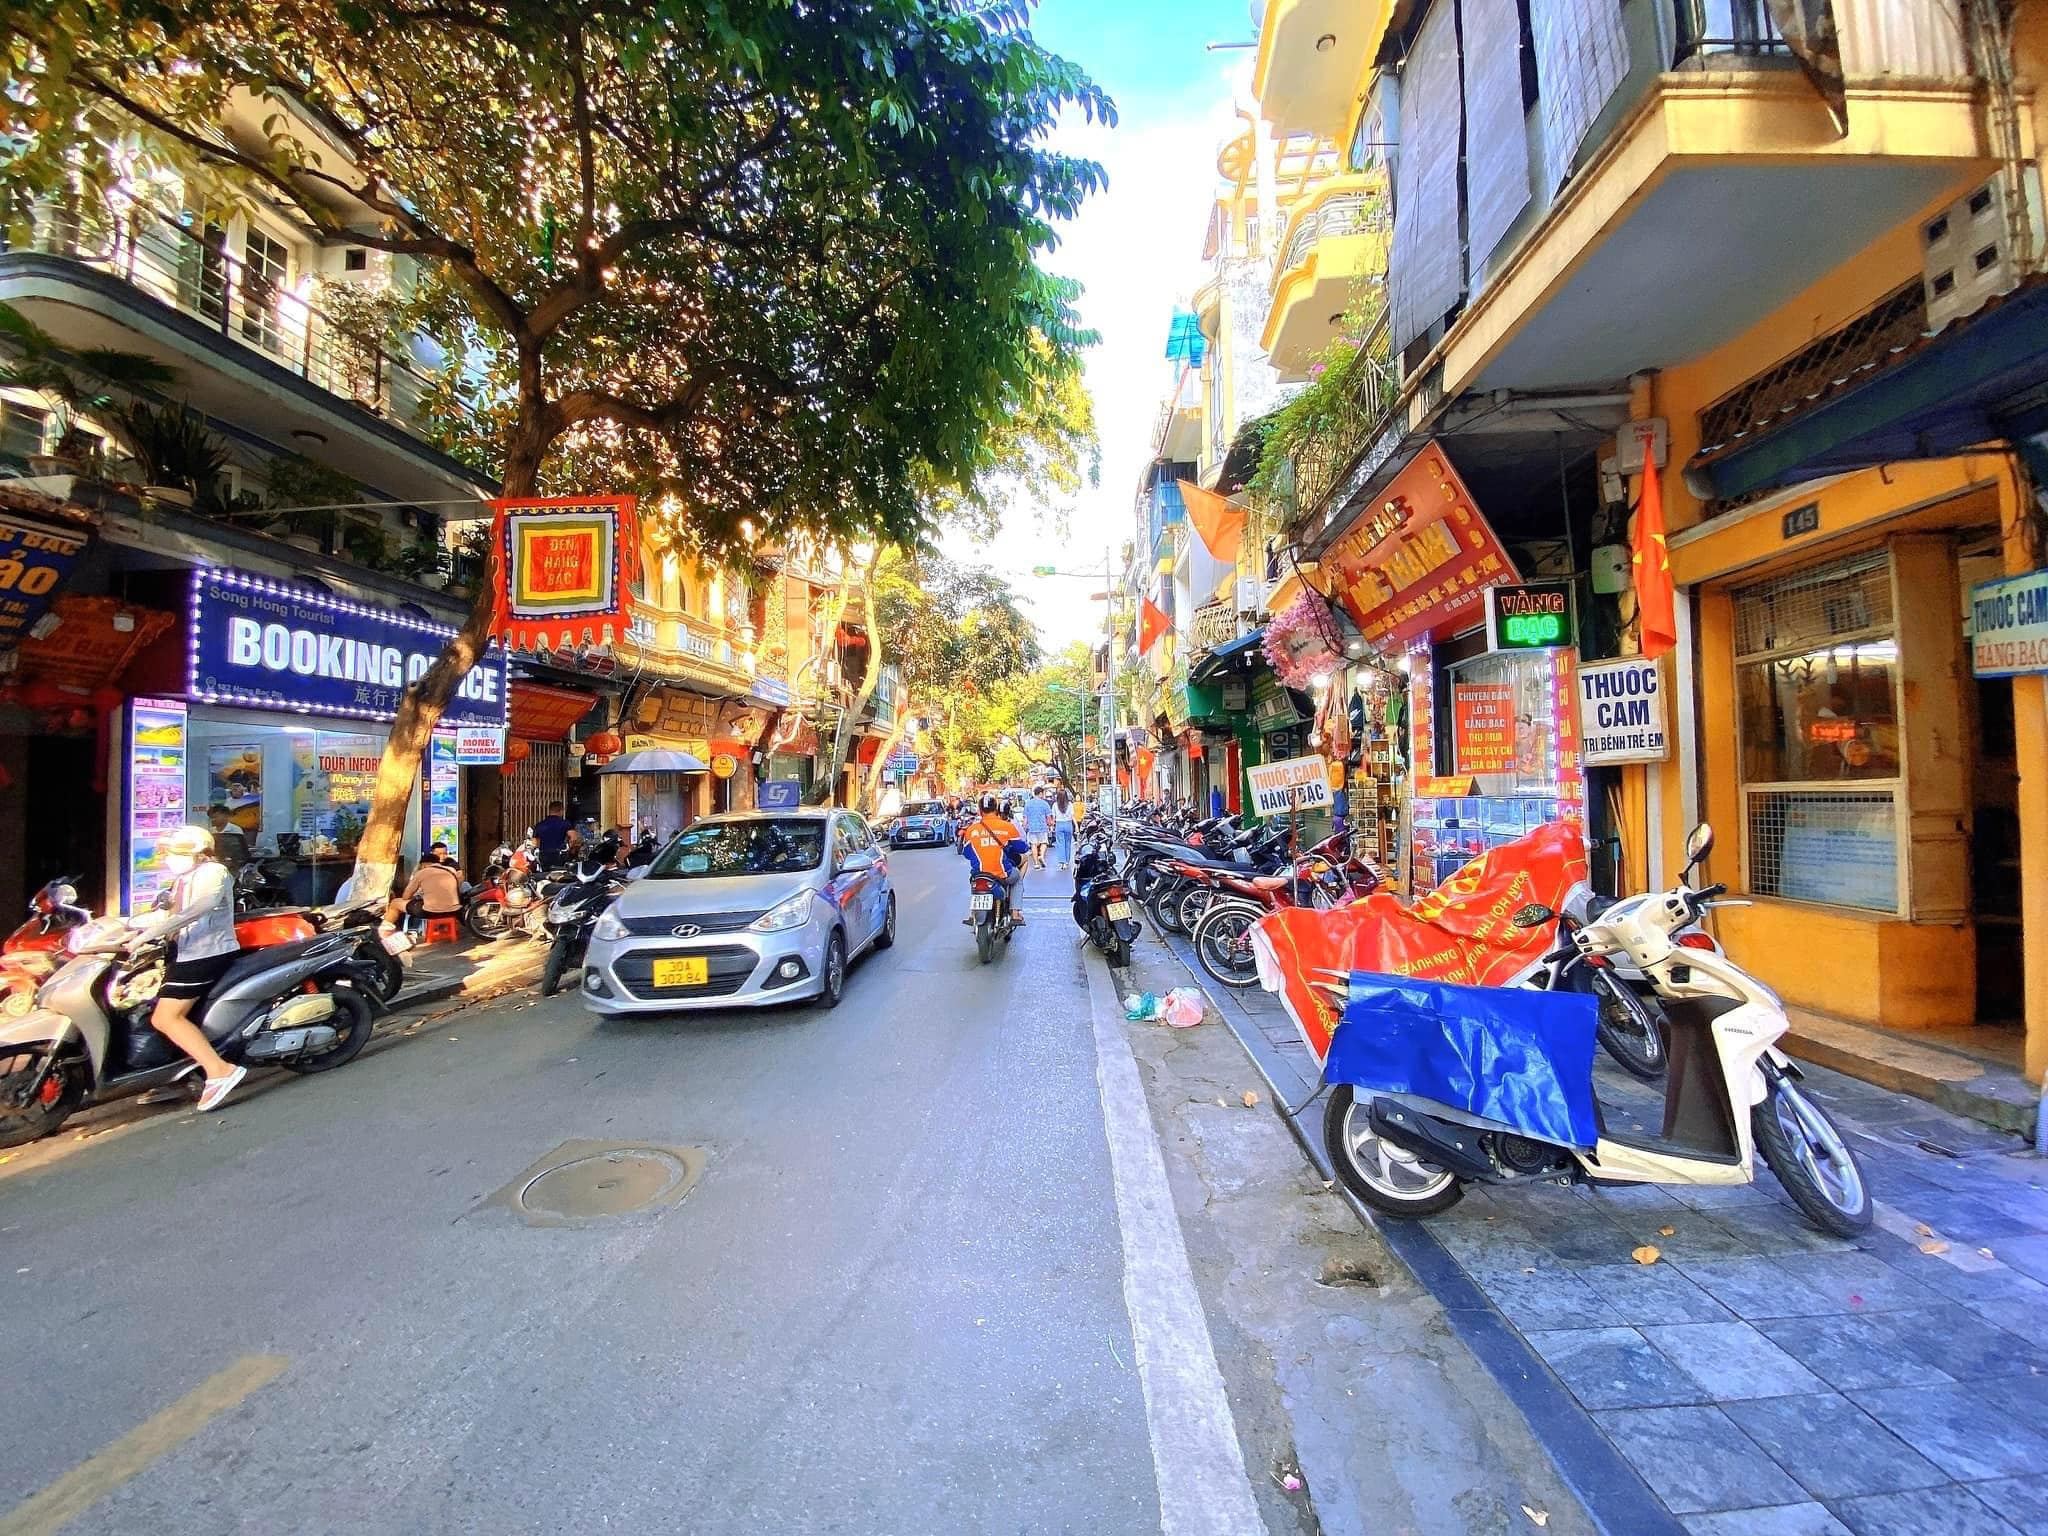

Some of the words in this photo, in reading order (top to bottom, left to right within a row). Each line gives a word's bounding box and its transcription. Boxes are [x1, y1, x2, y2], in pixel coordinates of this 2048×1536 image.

[210, 586, 249, 608] Song
[253, 597, 288, 617] Hong
[292, 605, 336, 625] Tourist
[1501, 590, 1564, 615] VÀNG
[228, 617, 402, 687] BOOKING
[1597, 700, 1650, 728] CAM
[463, 738, 496, 747] MONEY
[1648, 733, 1663, 747] EM
[318, 756, 346, 771] TOUR
[1294, 762, 1323, 783] CAM
[332, 774, 362, 787] Money
